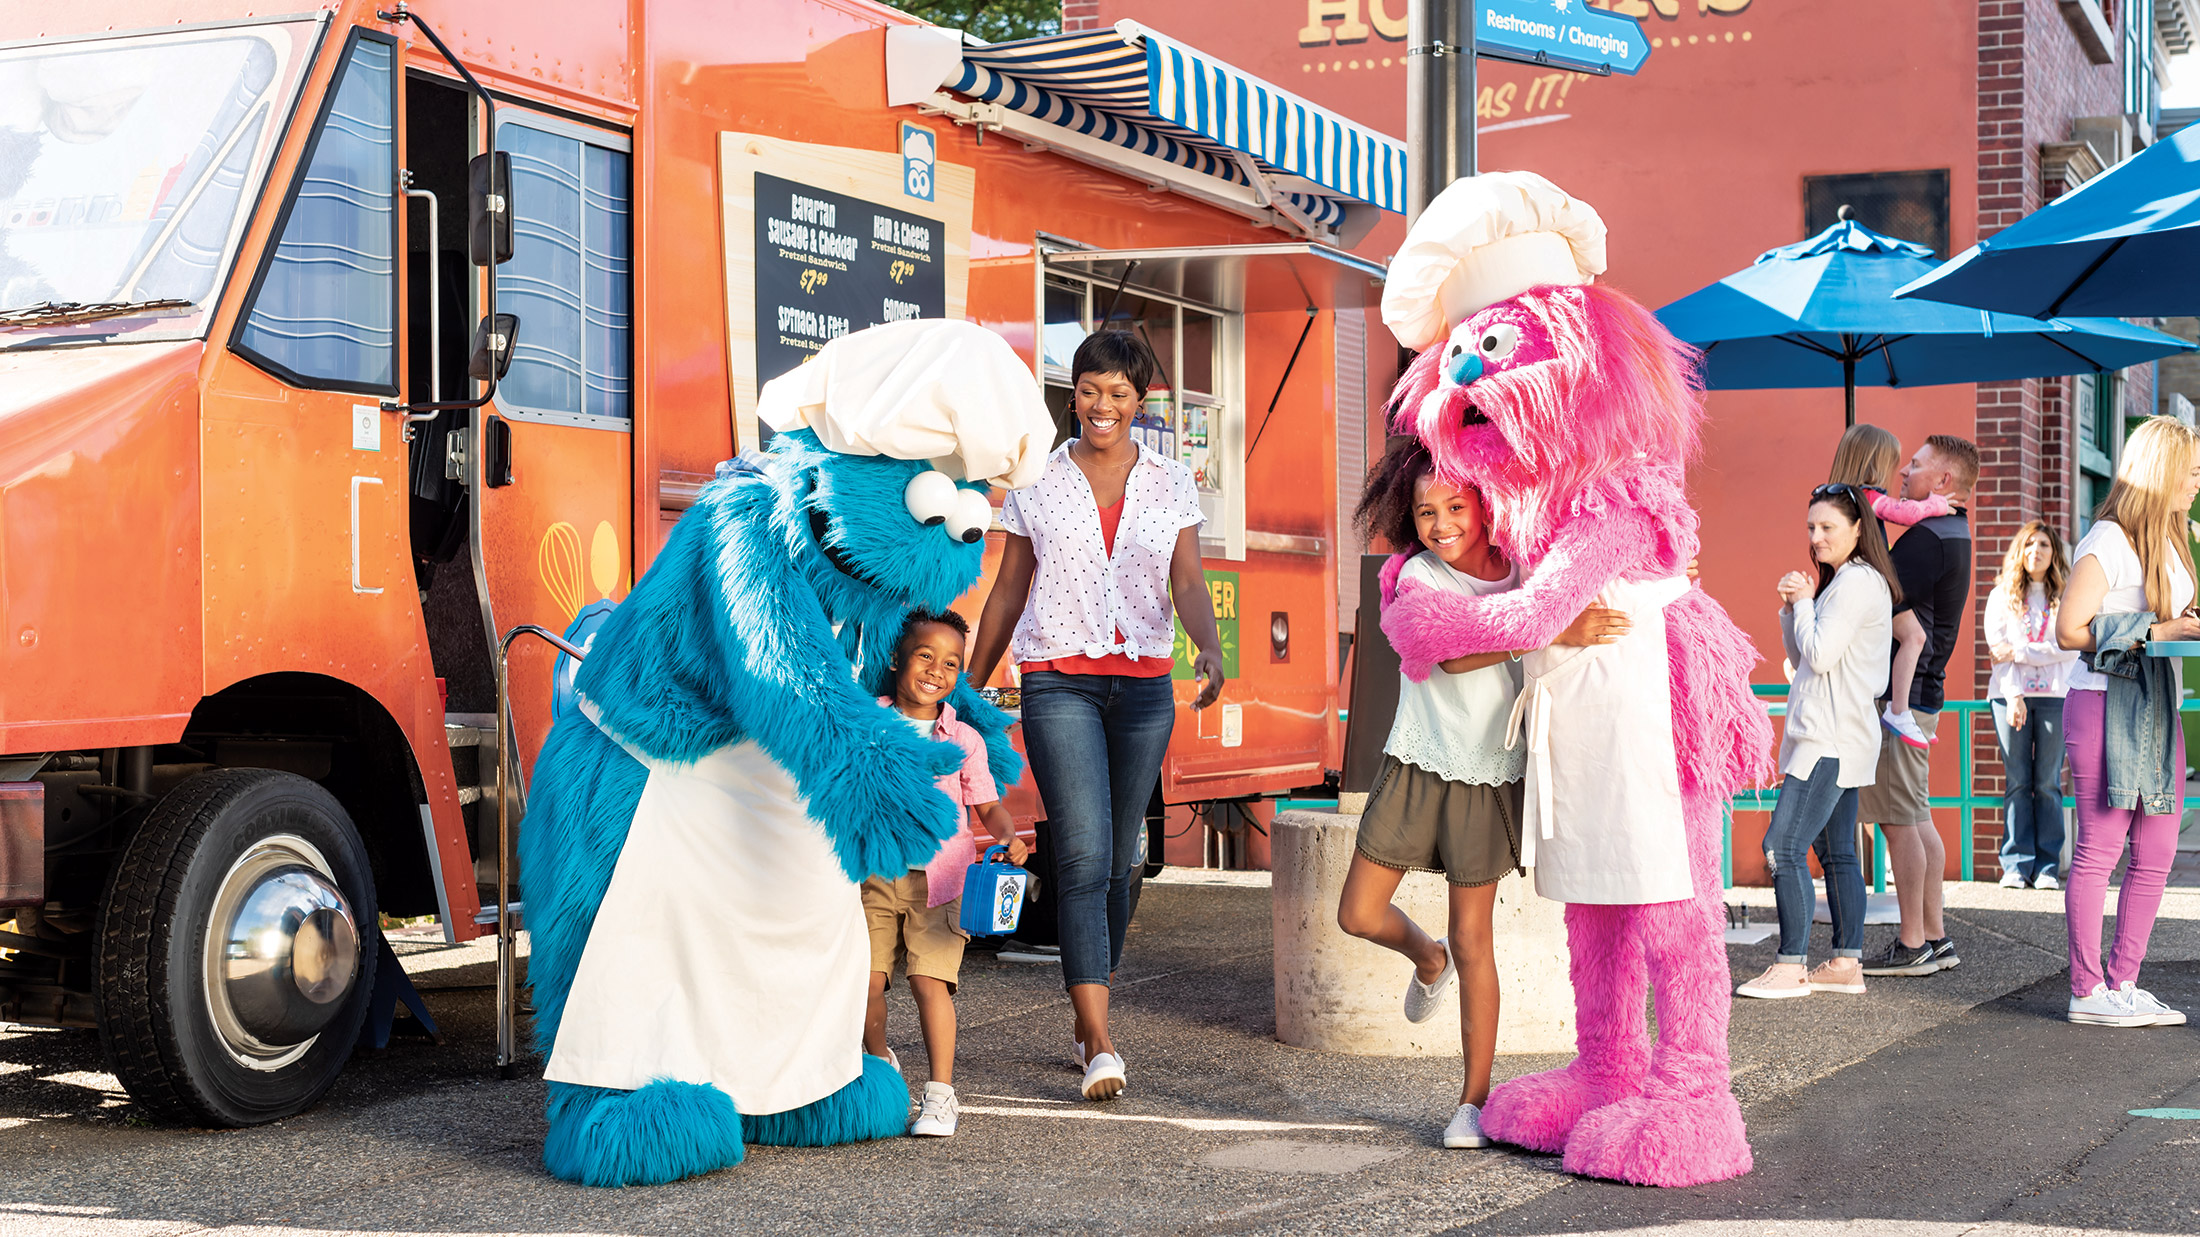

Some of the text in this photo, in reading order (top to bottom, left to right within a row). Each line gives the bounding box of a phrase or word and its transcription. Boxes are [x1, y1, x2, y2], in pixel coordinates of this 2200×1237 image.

[1486, 9, 1556, 40] Restrooms
[1558, 25, 1566, 43] /
[1568, 26, 1629, 59] Changing
[767, 216, 858, 262] Sausage & Cheddar
[873, 214, 930, 252] Ham & Cheese
[779, 248, 848, 272] Pretzel Sandwich
[871, 240, 931, 263] Pretzel Sandwich
[800, 268, 828, 295] $7.99
[889, 259, 915, 285] $7.99
[778, 304, 818, 337] Spinach
[818, 314, 827, 339] &
[780, 335, 808, 349] Pretzel
